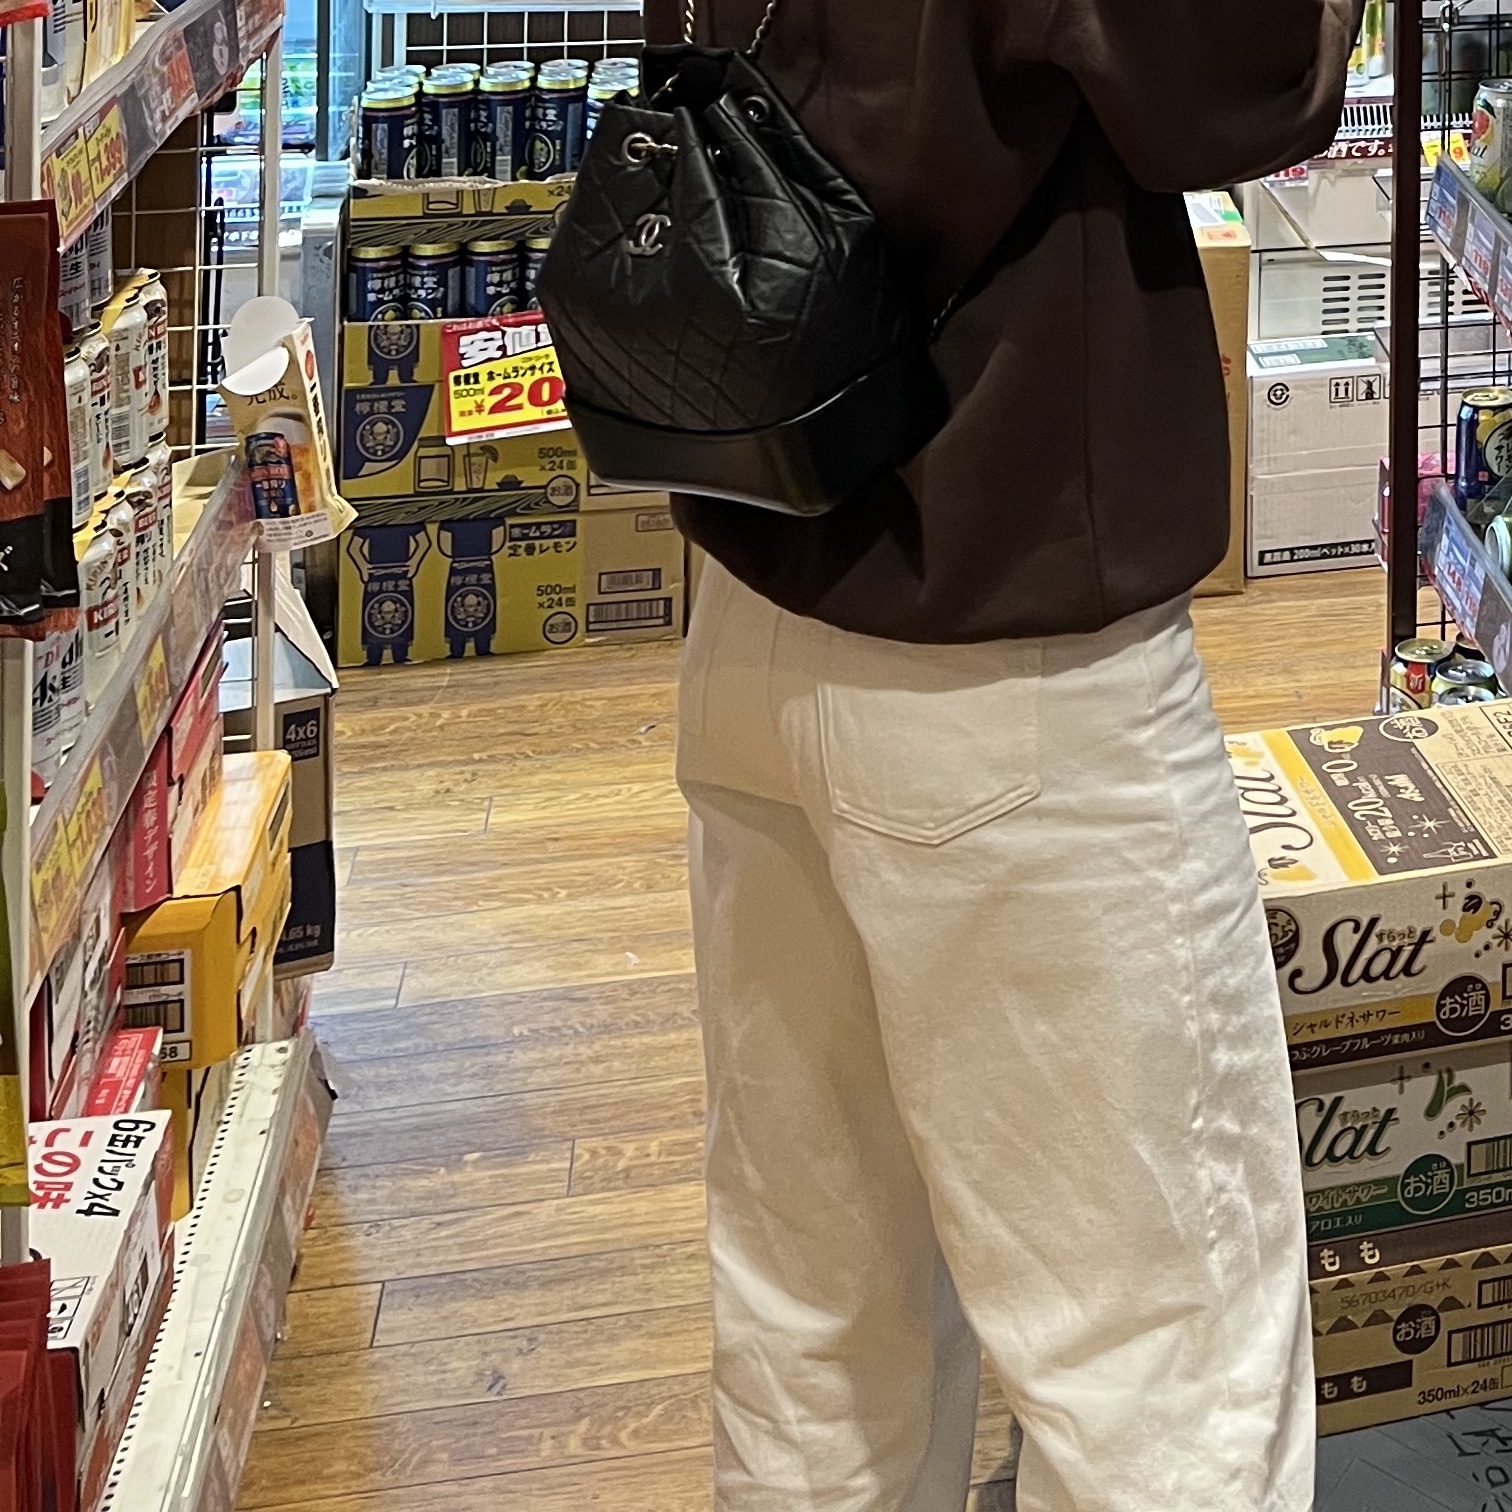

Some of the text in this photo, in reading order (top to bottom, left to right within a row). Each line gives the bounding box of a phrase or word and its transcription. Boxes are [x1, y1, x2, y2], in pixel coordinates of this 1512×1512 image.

[486, 359, 556, 383] ホームランサイズ
[537, 447, 578, 460] 500ml
[507, 541, 578, 558] 定番レモン
[535, 584, 577, 597] 500ml
[285, 718, 318, 741] 4x6
[1375, 927, 1417, 944] すらっと
[1288, 914, 1437, 995] Slat
[1440, 991, 1486, 1020] お酒
[1293, 1008, 1400, 1037] シャルドネサワー
[1404, 1165, 1451, 1198] お酒
[1309, 1213, 1363, 1234] アロエ入り
[1395, 1314, 1436, 1342] お酒
